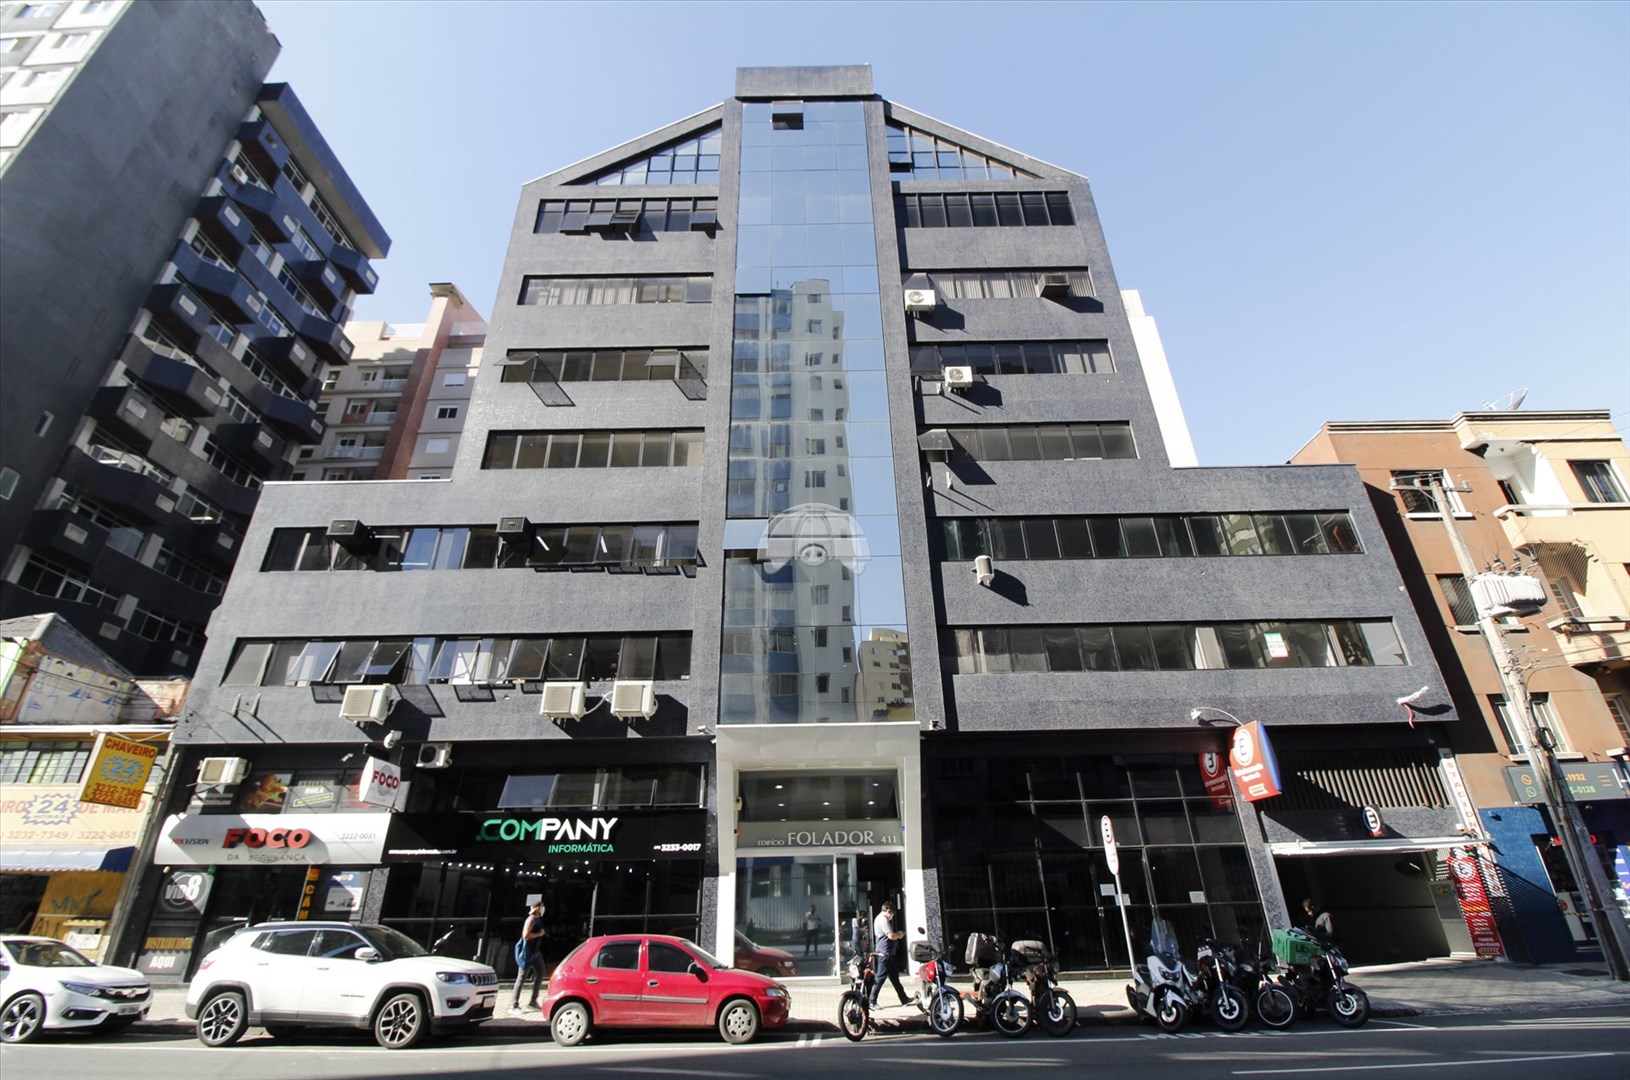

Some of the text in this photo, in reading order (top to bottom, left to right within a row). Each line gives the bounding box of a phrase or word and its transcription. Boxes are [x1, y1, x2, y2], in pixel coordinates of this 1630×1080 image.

[104, 738, 156, 758] CHAVEIRO
[110, 759, 137, 775] 24
[372, 770, 400, 790] FOCO
[37, 799, 69, 814] 24
[77, 801, 99, 814] DE
[7, 830, 137, 840] 3232-7349 3222-8451
[171, 837, 211, 846] HIKVISION
[221, 828, 312, 849] FOCO
[341, 832, 377, 840] 3222-0031
[757, 830, 897, 847] EDIFÍCIO FOLADOR 411
[548, 842, 614, 854] INFORMÁTICA
[660, 843, 702, 852] 3233-0017
[227, 853, 306, 862] DA SEGURANÇA
[149, 956, 176, 969] AQUI
